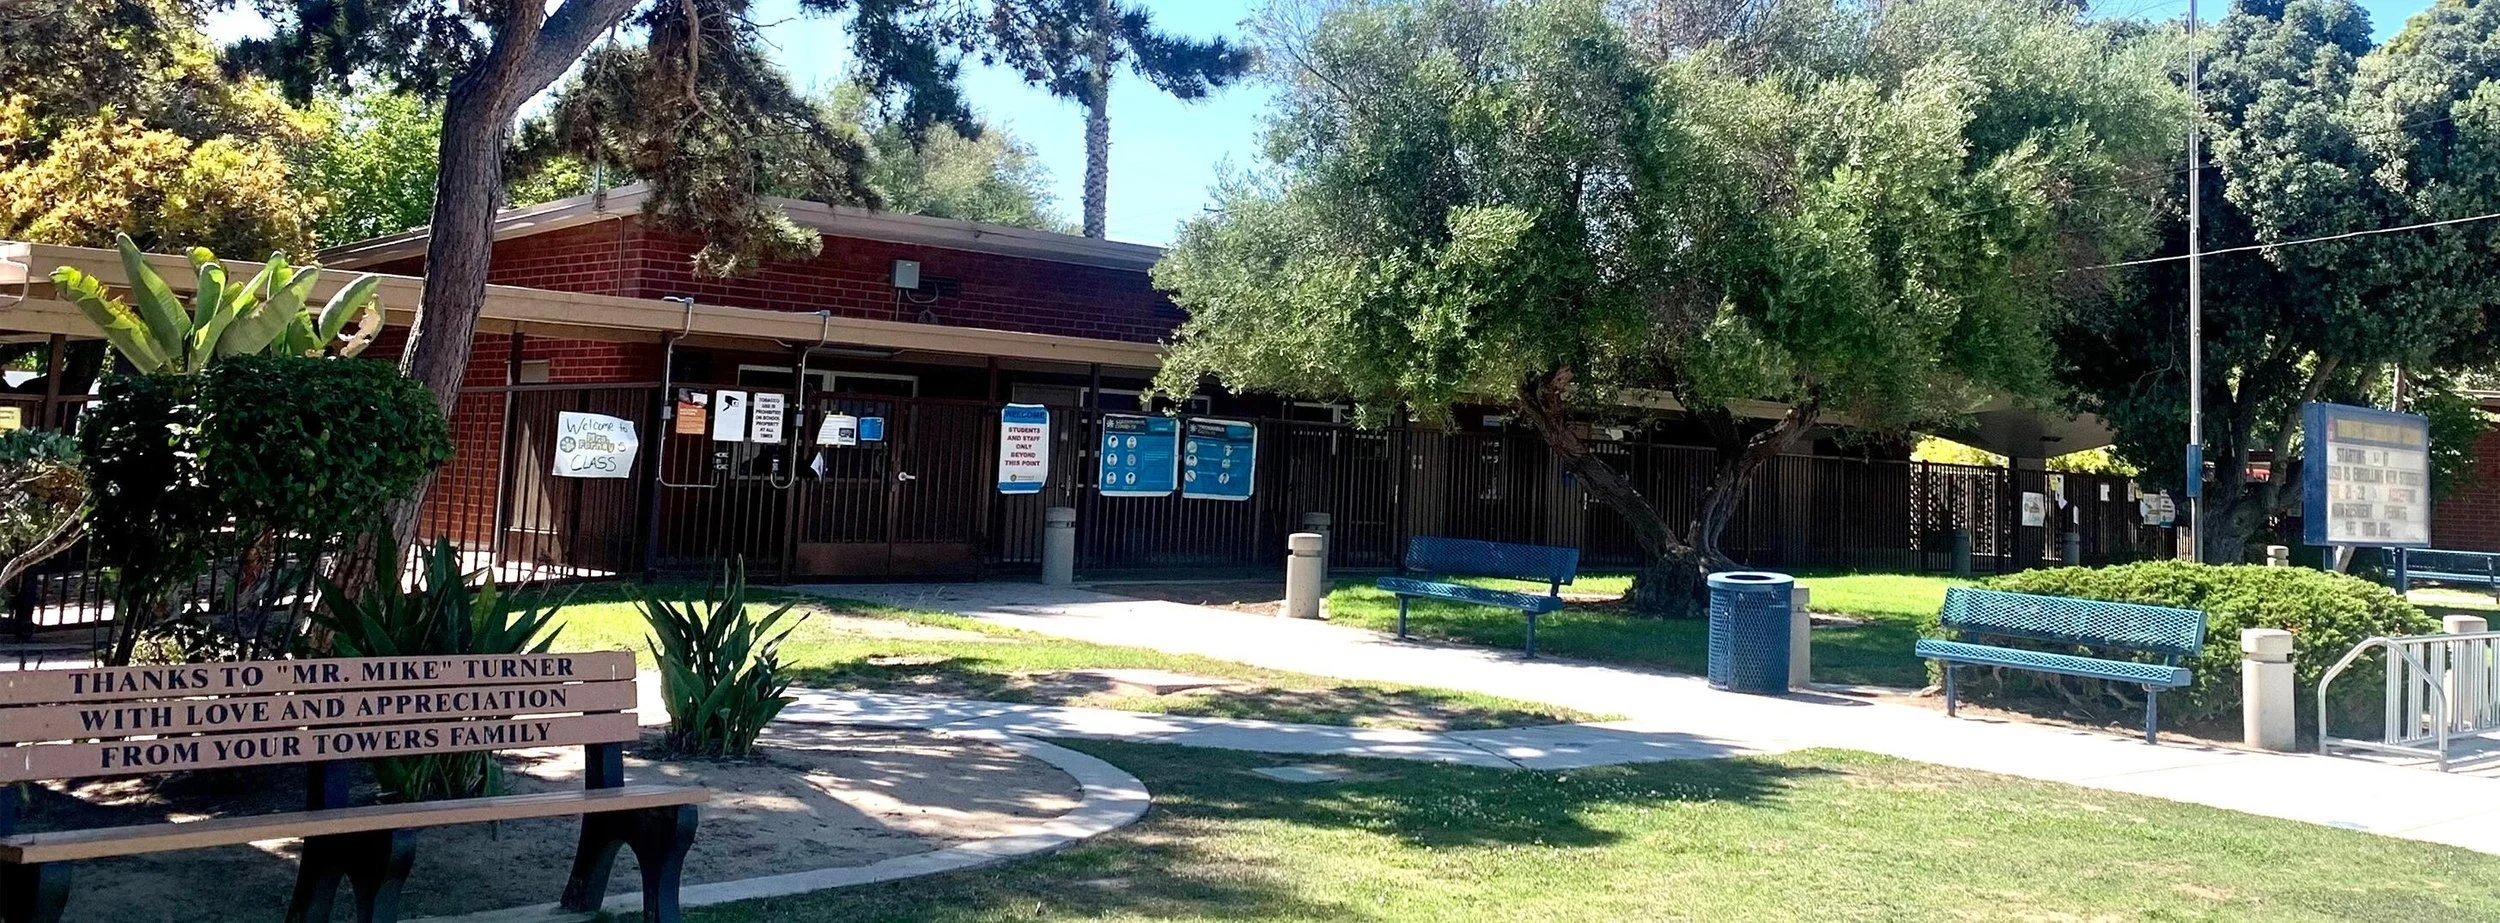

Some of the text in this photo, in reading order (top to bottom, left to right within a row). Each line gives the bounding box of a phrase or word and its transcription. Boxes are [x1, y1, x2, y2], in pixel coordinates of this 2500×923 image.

[566, 417, 628, 435] Welcome to
[571, 454, 617, 472] CLASS
[2337, 448, 2366, 464] STARTING
[68, 656, 574, 695] THANKS TO "MR. MIKE" TURNER
[80, 688, 567, 732] WITH LOVE AND APPRECIATION
[101, 721, 551, 769] FROM YOUR TOWERS FAMILY
